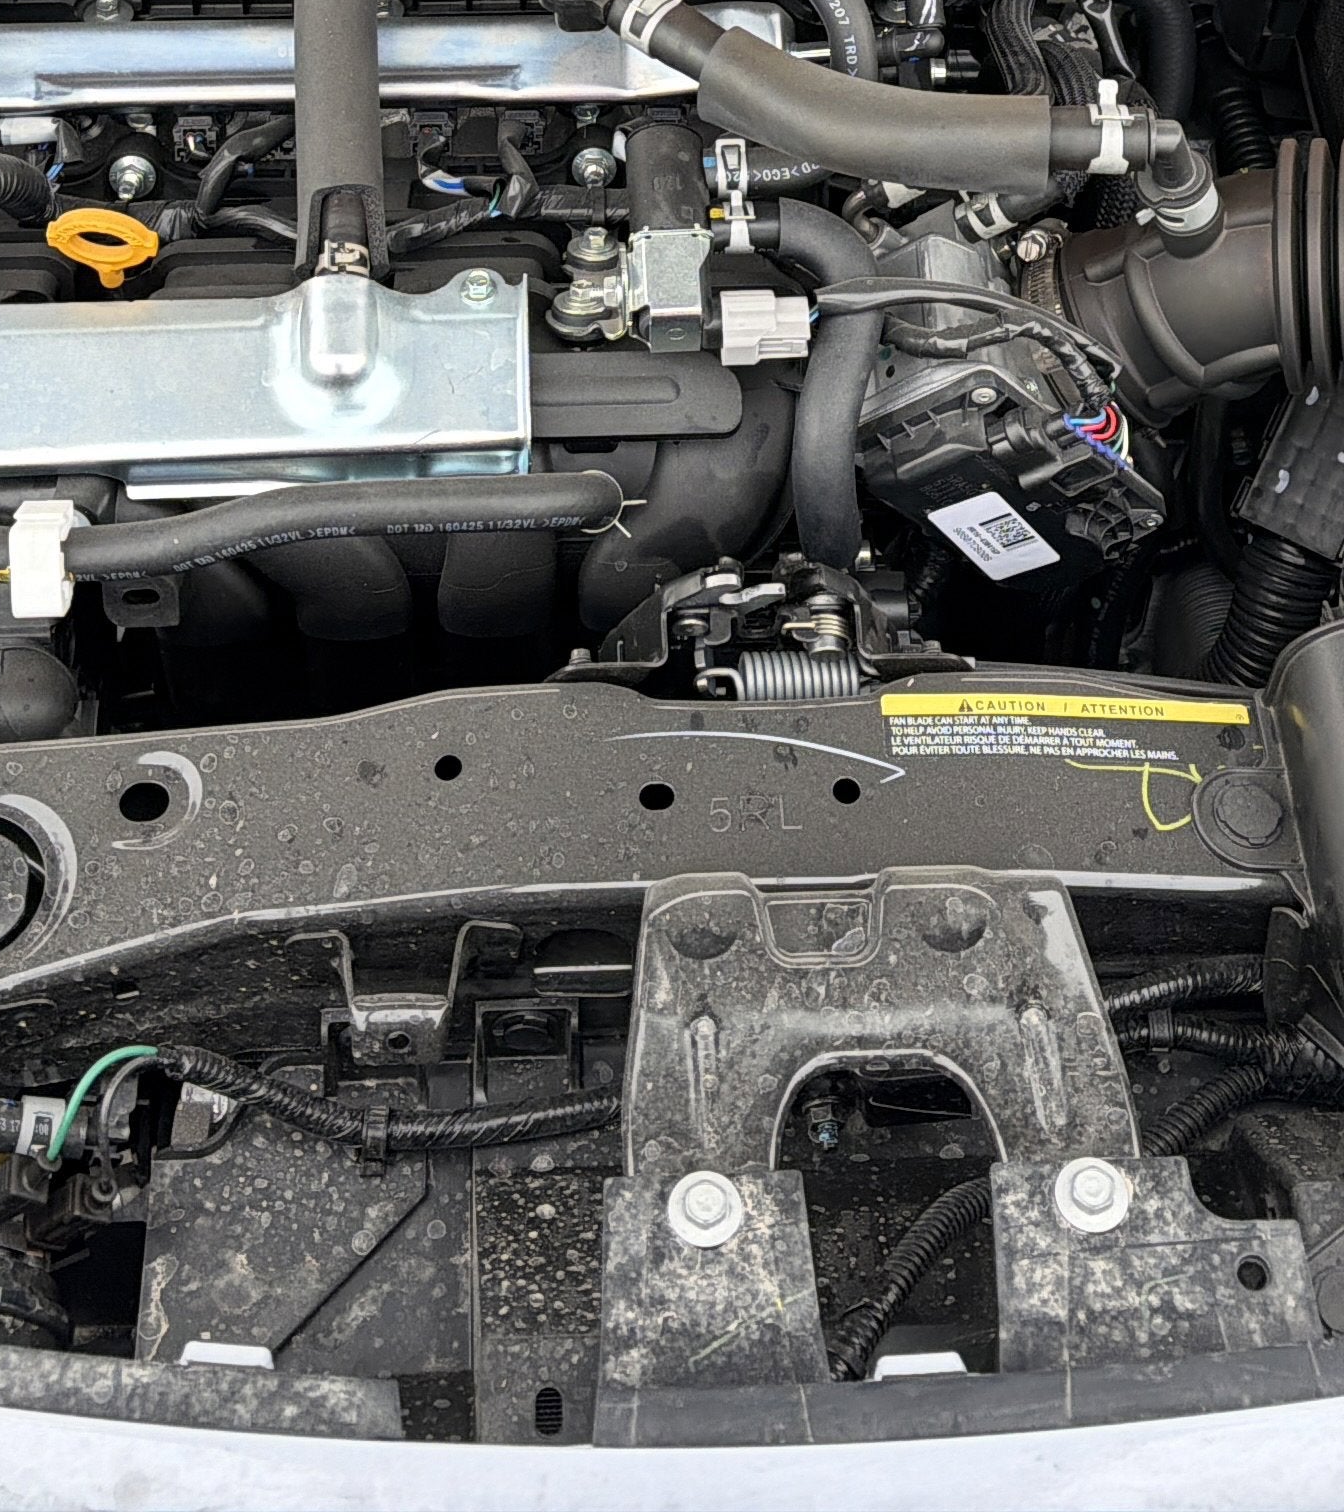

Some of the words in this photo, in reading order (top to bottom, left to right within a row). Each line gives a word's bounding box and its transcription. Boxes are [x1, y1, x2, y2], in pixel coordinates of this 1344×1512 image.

[975, 700, 1046, 712] CAUTION
[1081, 703, 1165, 717] ATTENTION
[889, 716, 906, 725] FAN
[907, 716, 934, 725] BLADE
[934, 716, 953, 725] CAN
[955, 716, 979, 725] START
[979, 716, 990, 725] AT
[991, 716, 1009, 725] ANY
[1009, 716, 1032, 726] TIME.
[891, 726, 903, 735] TO
[904, 726, 925, 735] HELP
[926, 725, 952, 735] AVOID
[953, 726, 996, 735] PERSONAL
[1027, 726, 1048, 736] KEEP
[1049, 727, 1077, 736] HANDS
[891, 736, 902, 745] LE
[903, 735, 963, 745] VENTILATEUR
[964, 735, 997, 745] RISQUE
[998, 735, 1011, 744] DE
[1012, 734, 1060, 745] DÉMARRER
[1070, 737, 1094, 746] TOUT
[1095, 738, 1139, 748] MOMENT.
[892, 746, 919, 756] POUR
[919, 744, 950, 755] ÉVITER
[951, 745, 981, 755] TOUTE
[1029, 746, 1042, 755] NE
[1043, 746, 1060, 755] PAS
[1061, 746, 1074, 756] EN
[1076, 746, 1129, 758] APPROCHER
[1130, 749, 1146, 759] LES
[709, 795, 803, 833] 5RL
